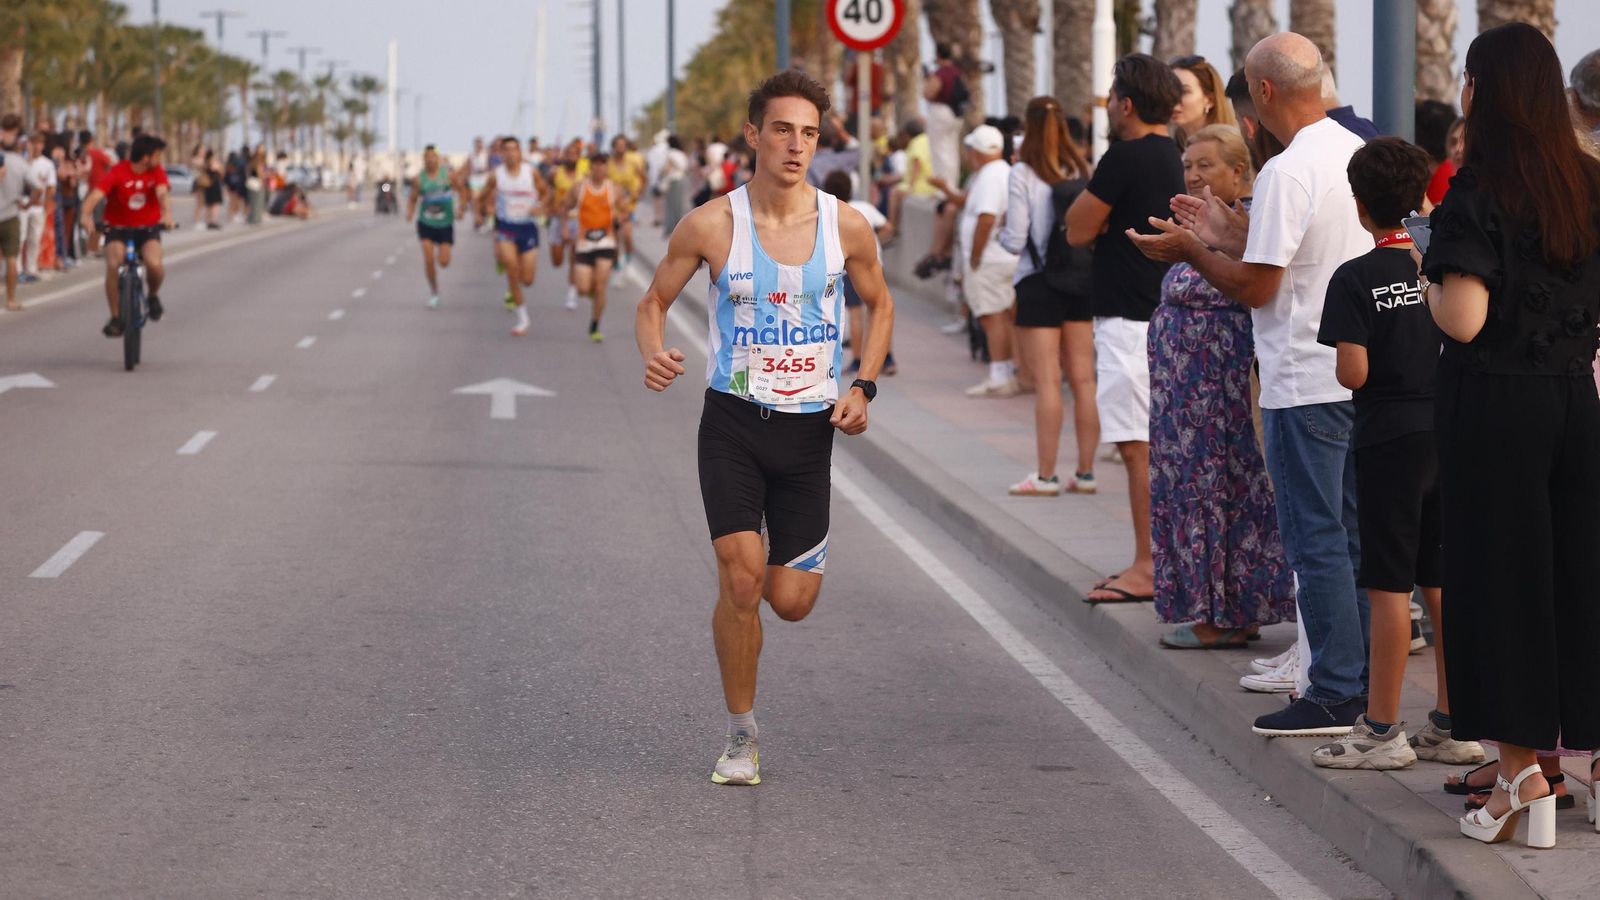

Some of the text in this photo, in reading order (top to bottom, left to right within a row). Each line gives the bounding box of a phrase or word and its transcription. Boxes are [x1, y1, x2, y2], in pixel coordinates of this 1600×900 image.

[844, 0, 882, 24] 40
[730, 271, 753, 281] vive
[1375, 292, 1424, 312] NACI
[762, 356, 816, 374] 3455
